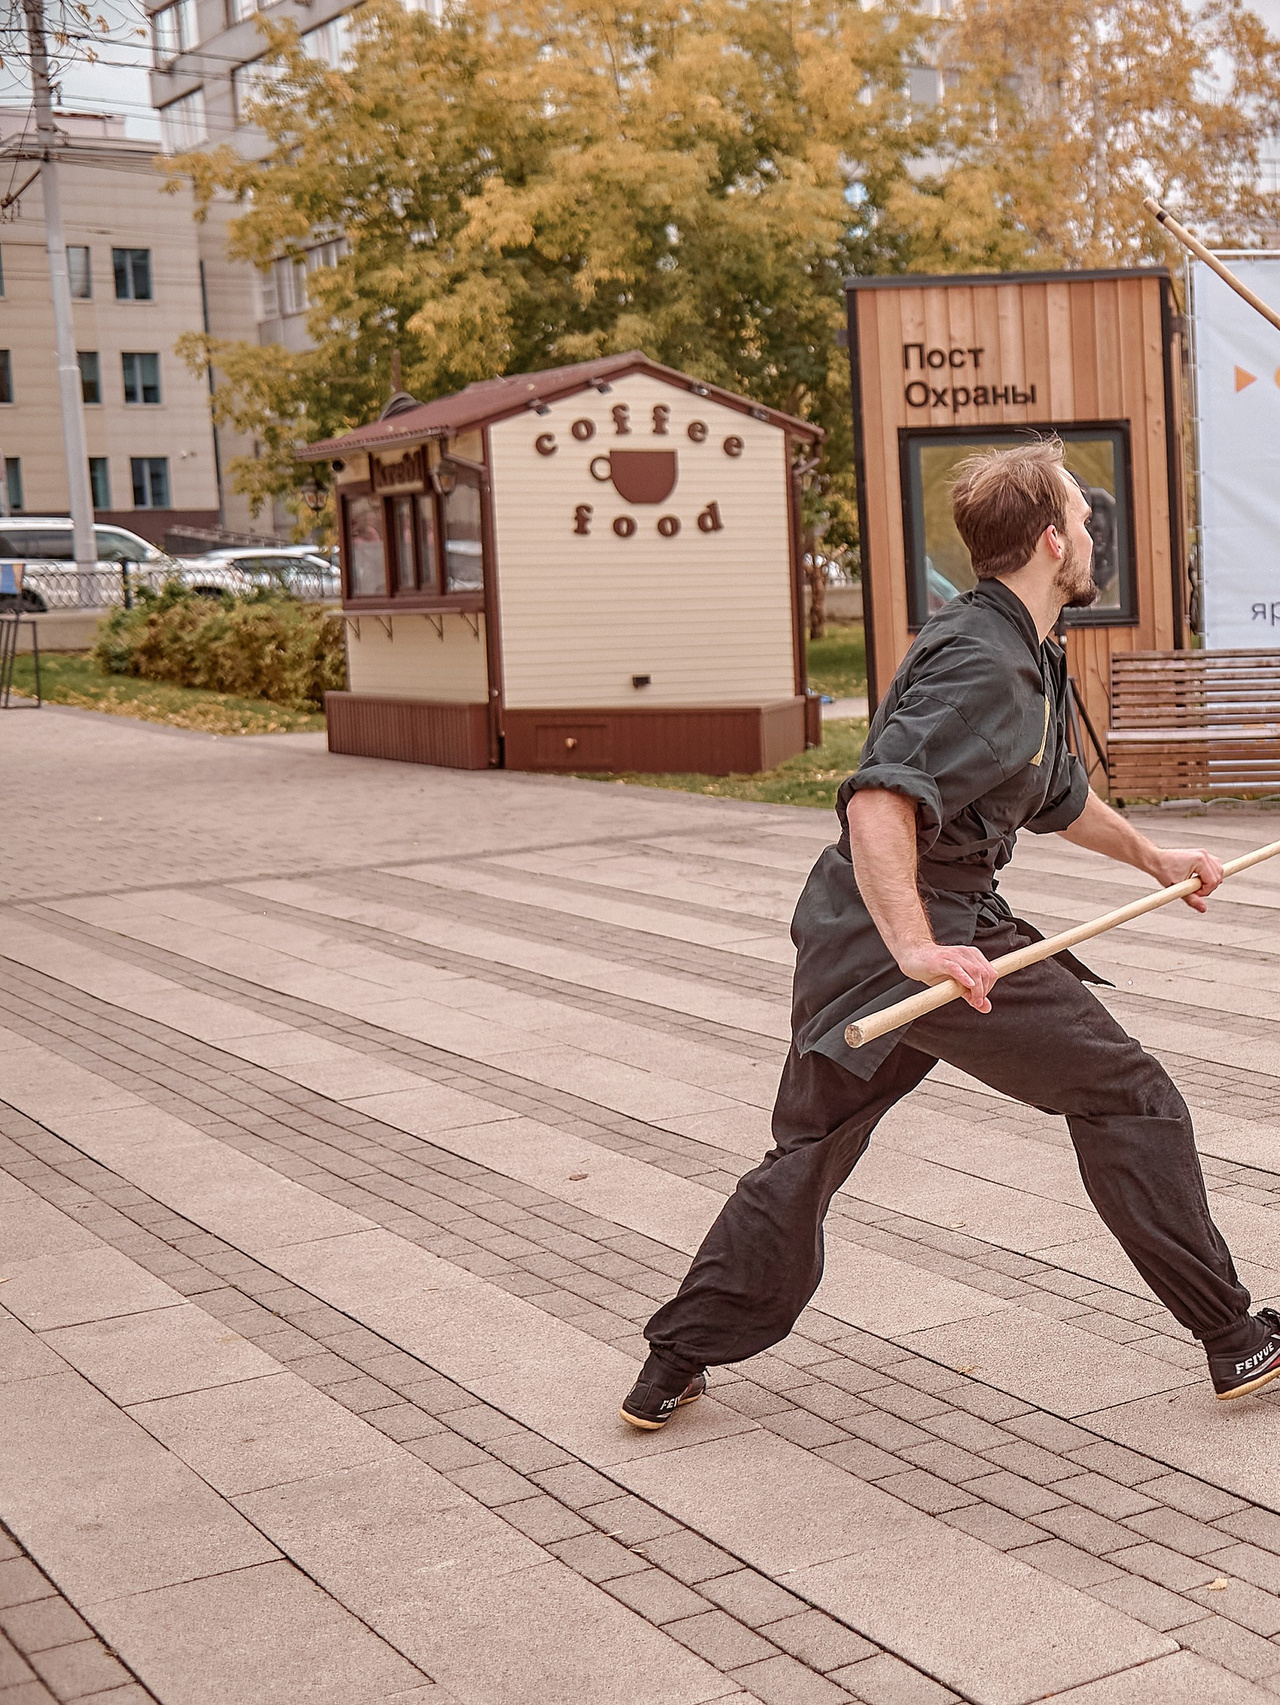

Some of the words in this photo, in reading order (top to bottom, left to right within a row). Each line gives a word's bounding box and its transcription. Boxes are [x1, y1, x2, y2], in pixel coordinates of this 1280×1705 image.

[903, 342, 985, 370] Пост
[904, 380, 1038, 413] Охраны
[535, 403, 745, 457] coffee
[573, 501, 725, 537] food
[1235, 1341, 1275, 1375] FEIYUE
